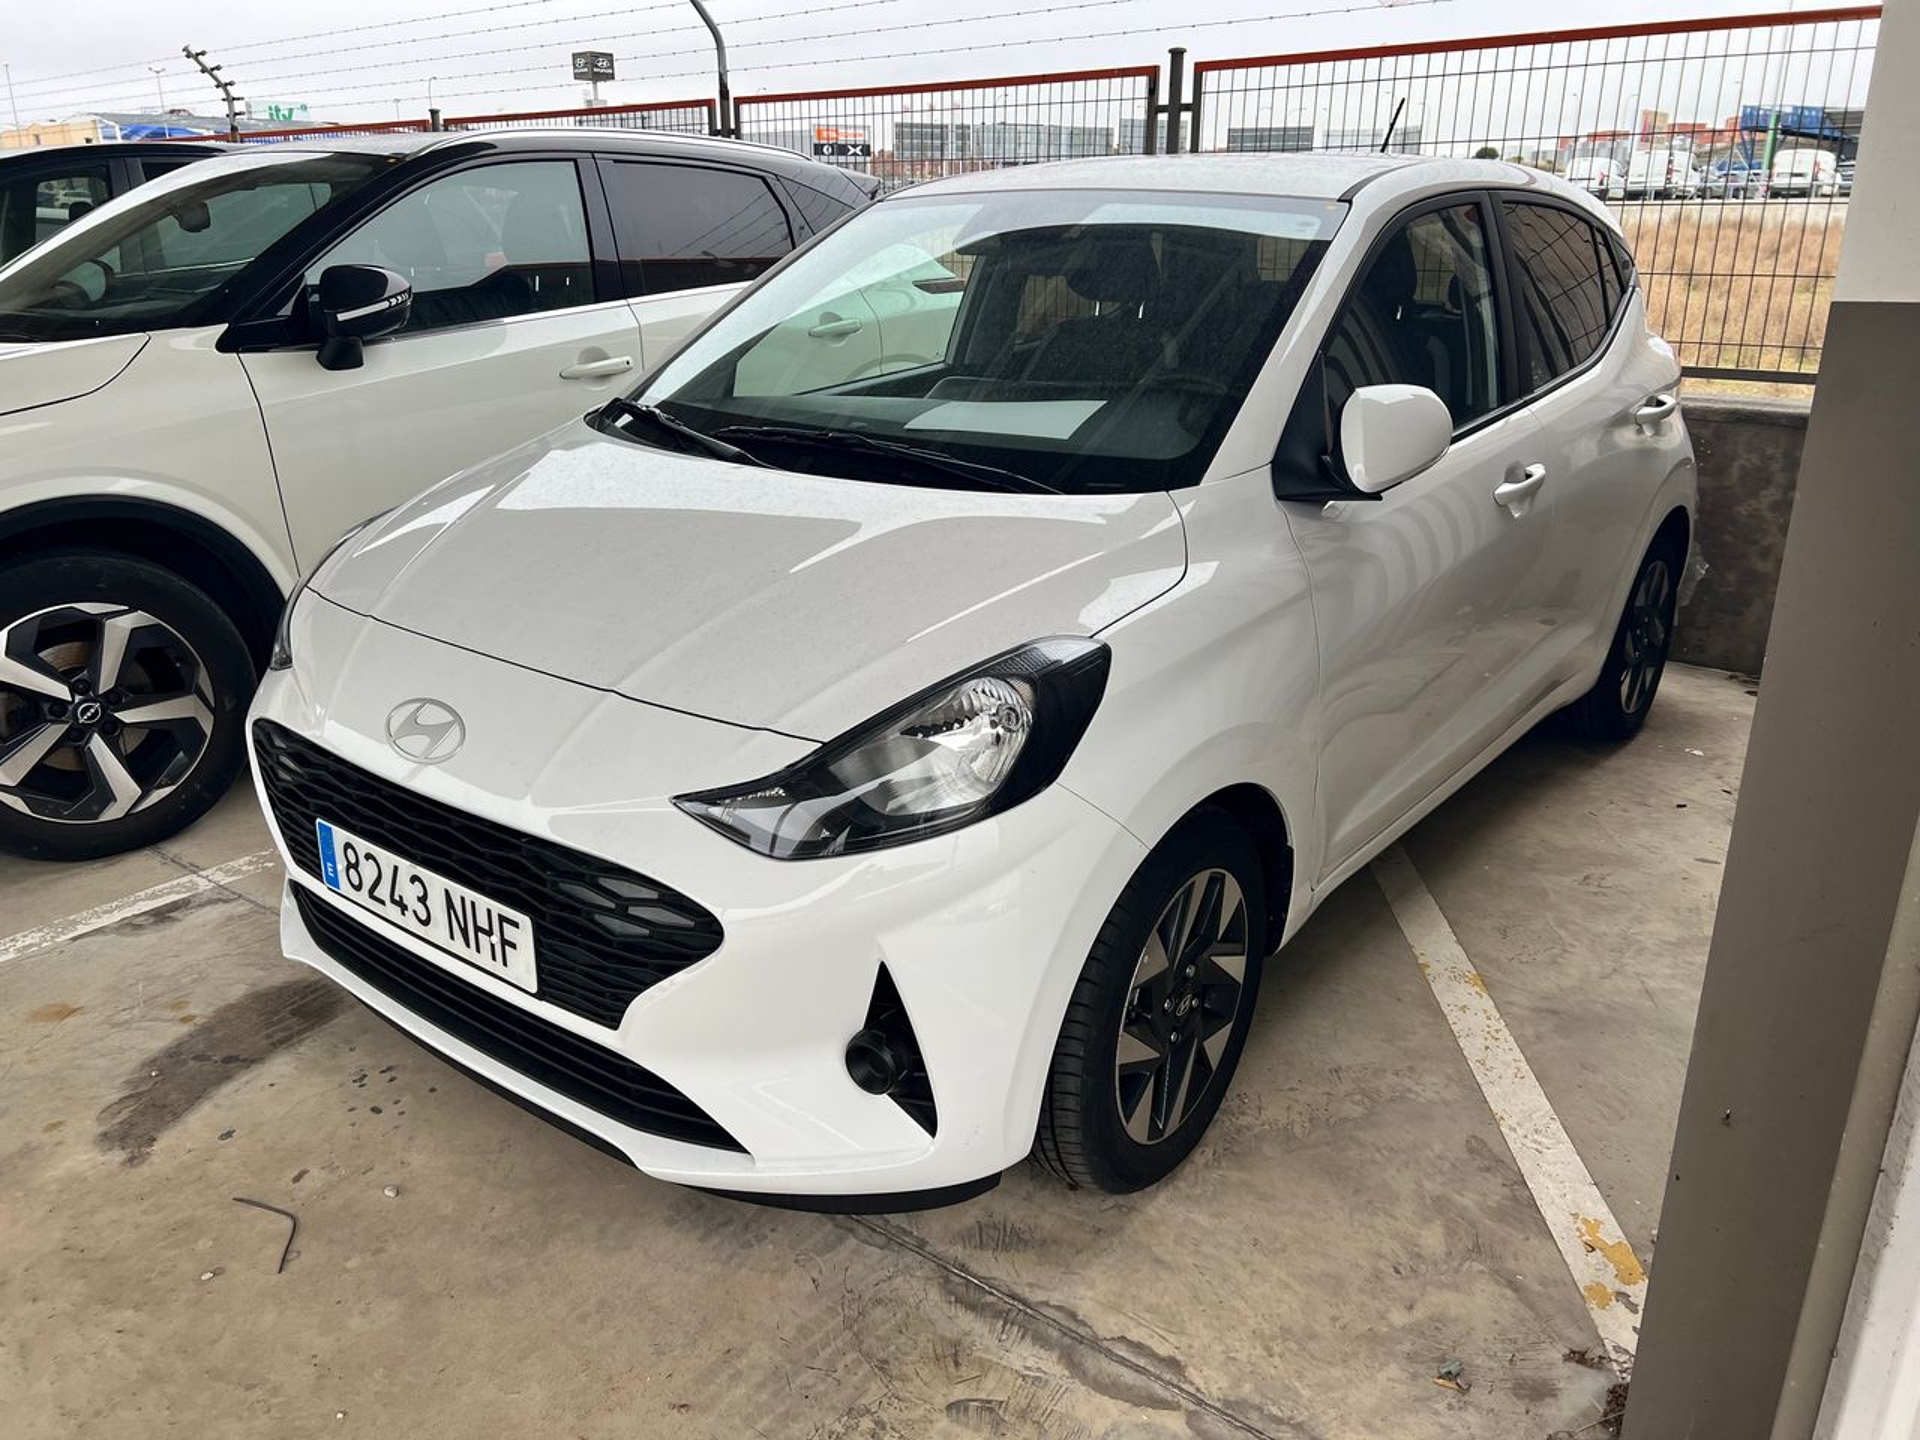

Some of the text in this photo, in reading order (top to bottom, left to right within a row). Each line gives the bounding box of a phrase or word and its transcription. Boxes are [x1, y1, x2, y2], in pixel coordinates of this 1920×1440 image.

[326, 861, 335, 877] E
[343, 841, 520, 968] 8243 NHF
